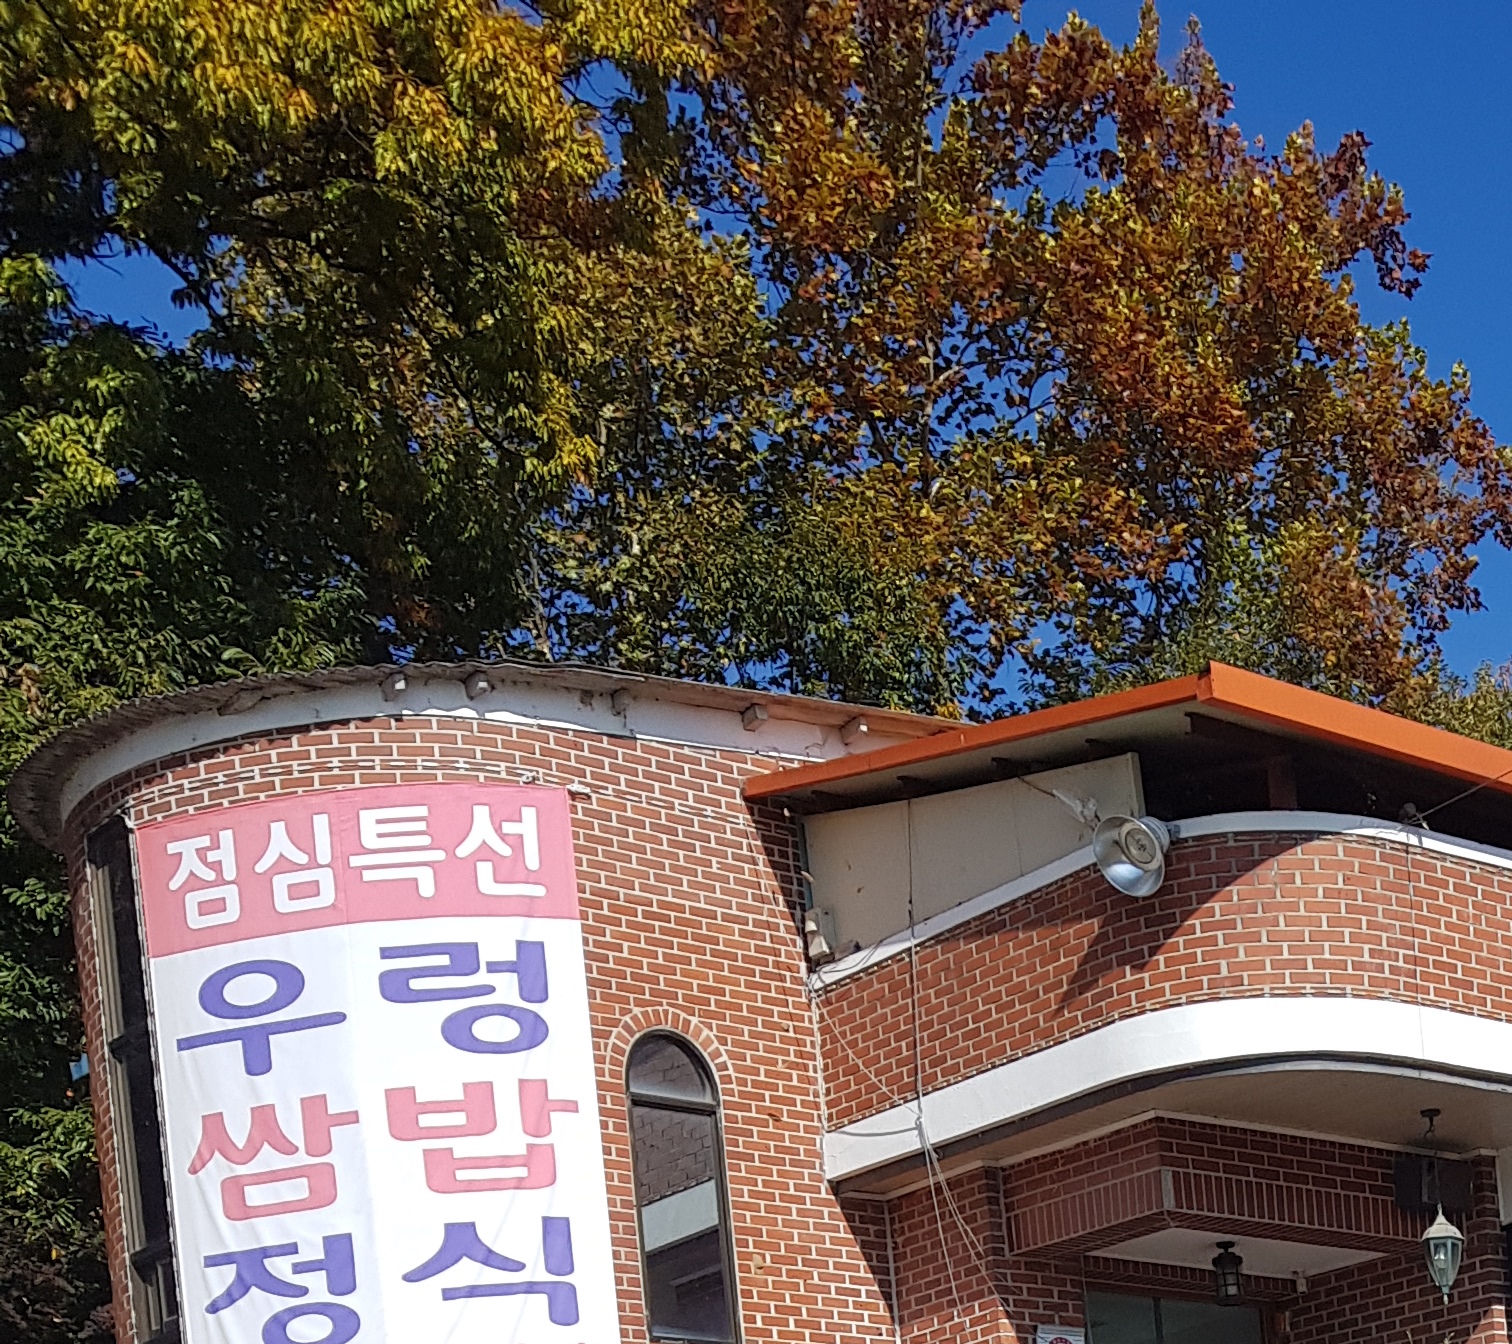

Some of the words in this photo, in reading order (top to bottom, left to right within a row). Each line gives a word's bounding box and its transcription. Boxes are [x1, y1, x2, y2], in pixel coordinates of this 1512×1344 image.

[165, 802, 547, 928] 점심특선
[176, 940, 549, 1076] 우렁
[187, 1078, 579, 1221] 쌈밥
